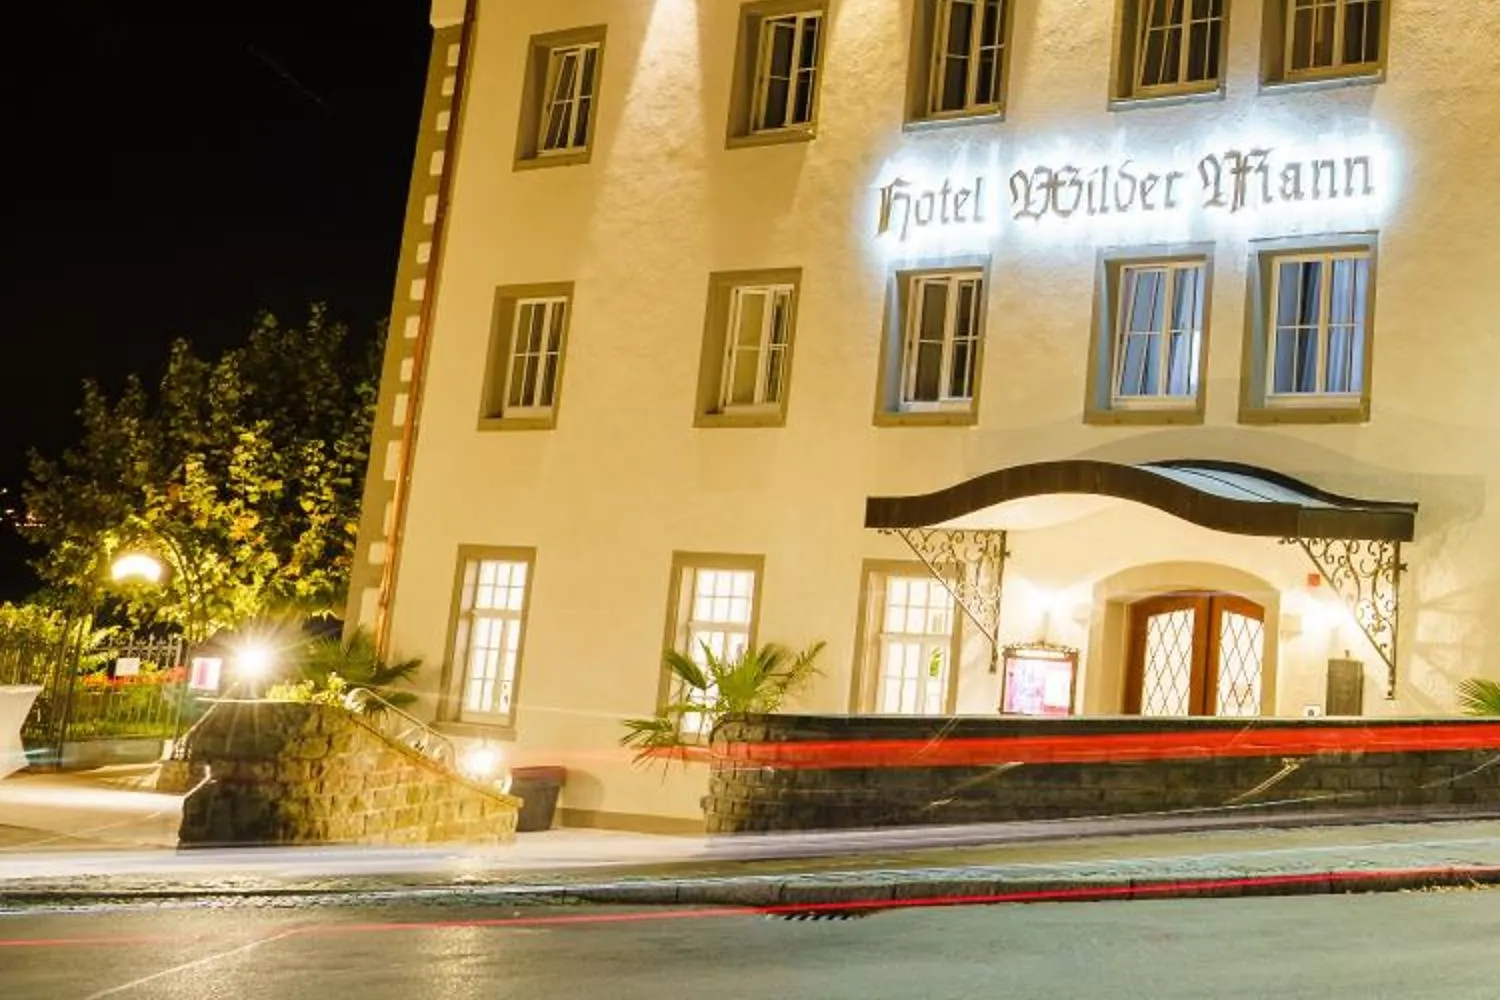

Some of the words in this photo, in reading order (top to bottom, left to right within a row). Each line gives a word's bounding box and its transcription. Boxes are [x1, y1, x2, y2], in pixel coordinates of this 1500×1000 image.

[876, 176, 985, 242] Hotel
[1009, 159, 1184, 221] Wilder
[1197, 147, 1374, 214] Mann
